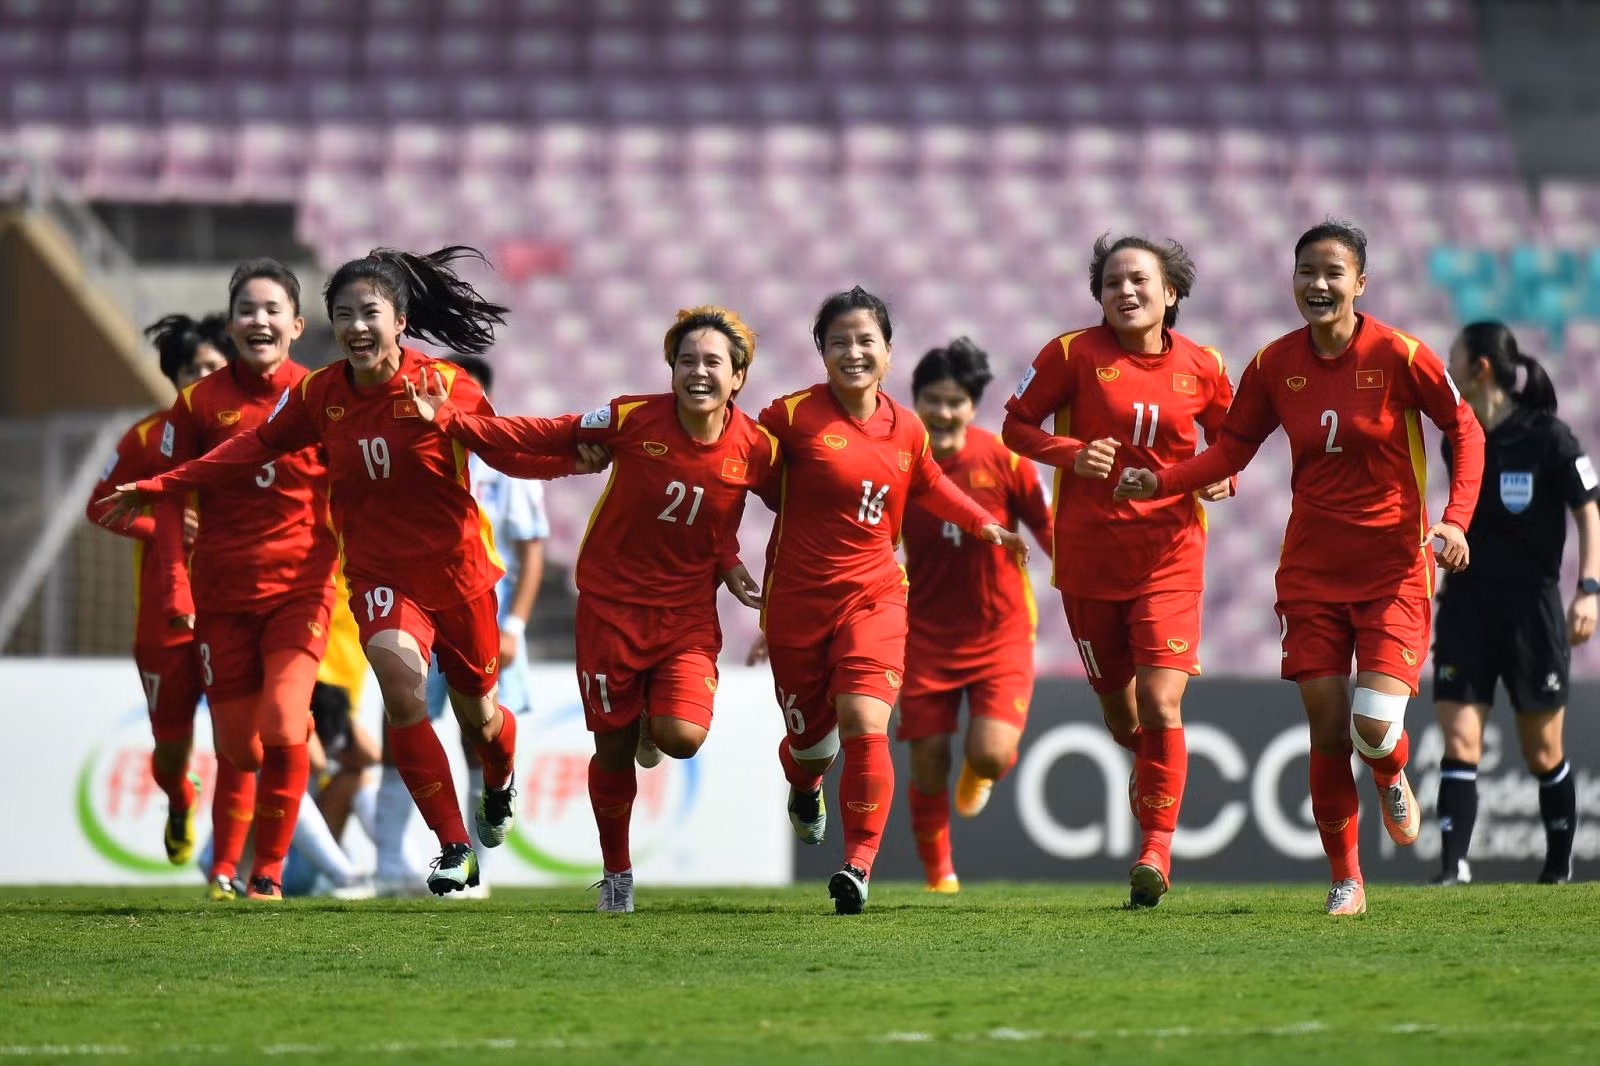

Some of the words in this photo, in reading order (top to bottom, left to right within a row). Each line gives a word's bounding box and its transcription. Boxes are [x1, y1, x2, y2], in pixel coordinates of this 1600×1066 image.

[1132, 402, 1159, 448] 11
[1320, 409, 1343, 453] 2
[358, 436, 391, 480] 19
[657, 480, 705, 526] 21
[858, 479, 890, 525] 16
[942, 520, 962, 547] 4
[364, 586, 394, 622] 19
[199, 643, 213, 686] 3
